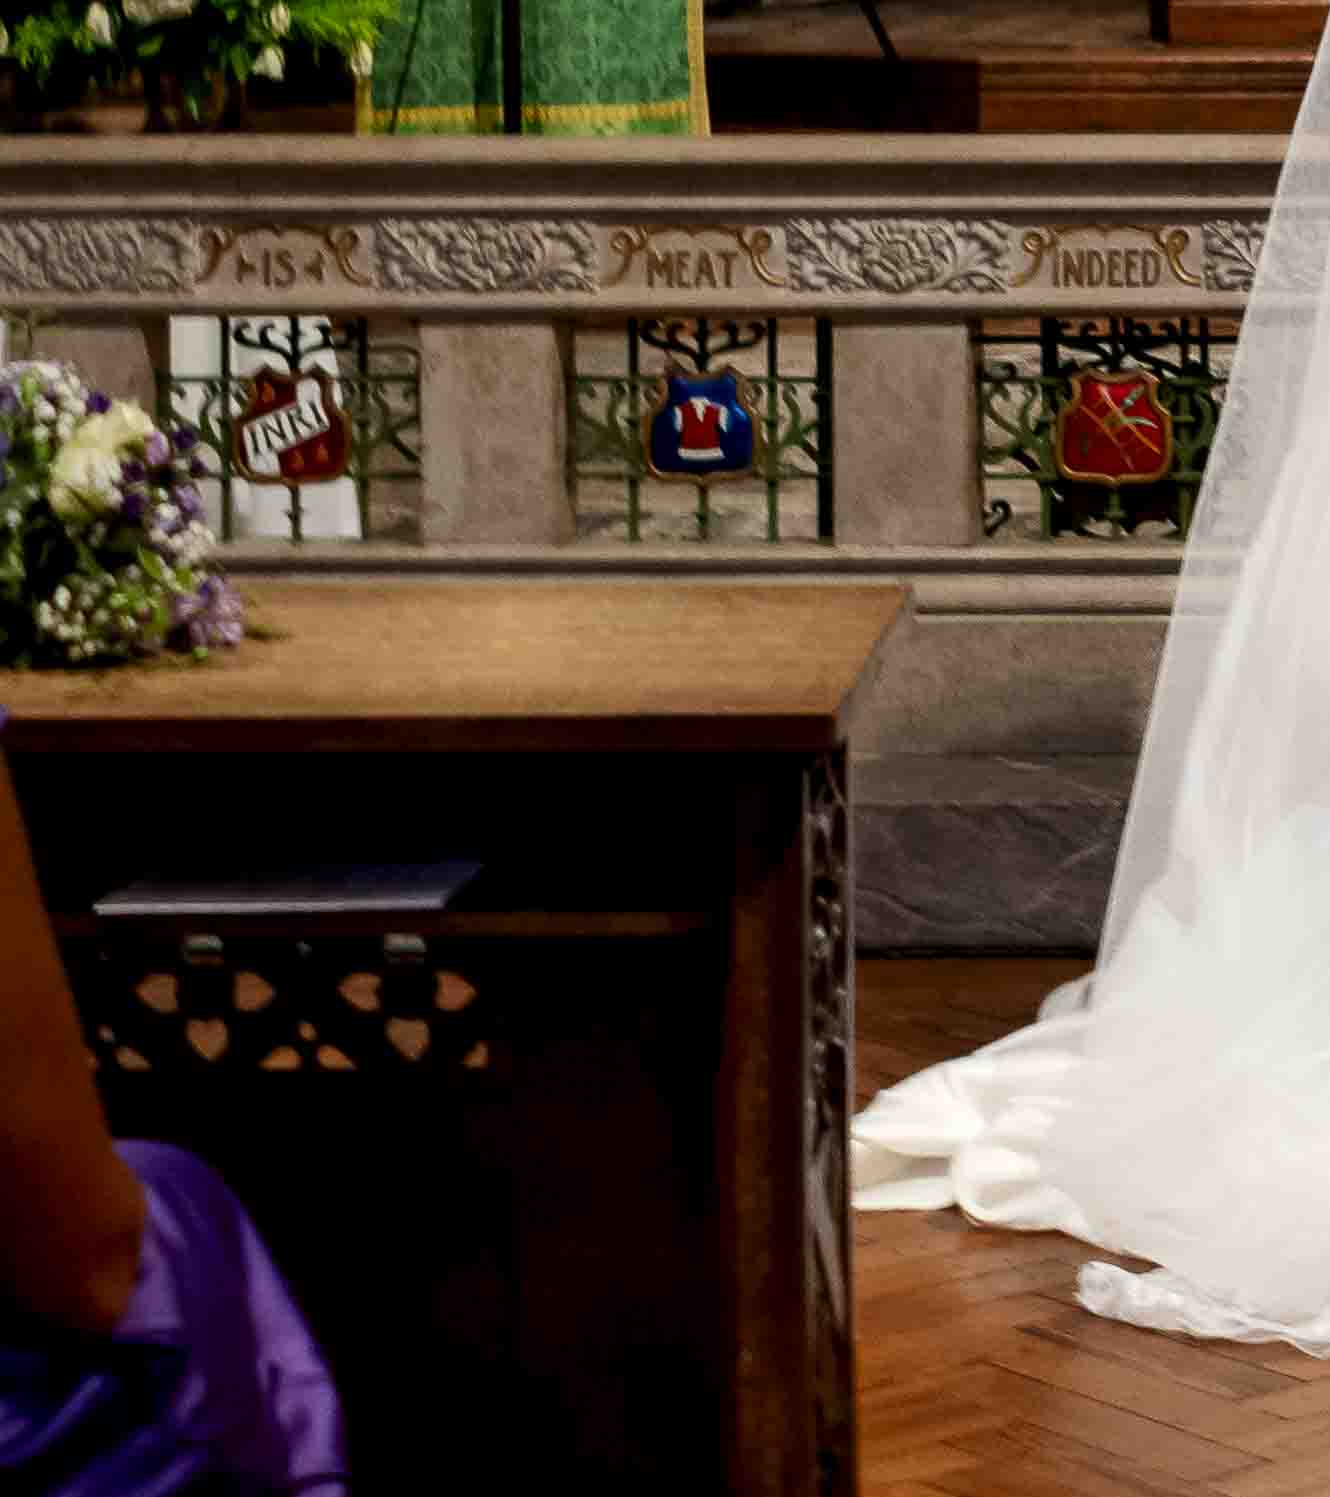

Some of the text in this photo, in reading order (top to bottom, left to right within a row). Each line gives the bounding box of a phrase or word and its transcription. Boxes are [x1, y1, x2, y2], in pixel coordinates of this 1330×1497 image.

[262, 249, 1161, 289] IS MEAT INDEED
[249, 401, 326, 454] INRI
